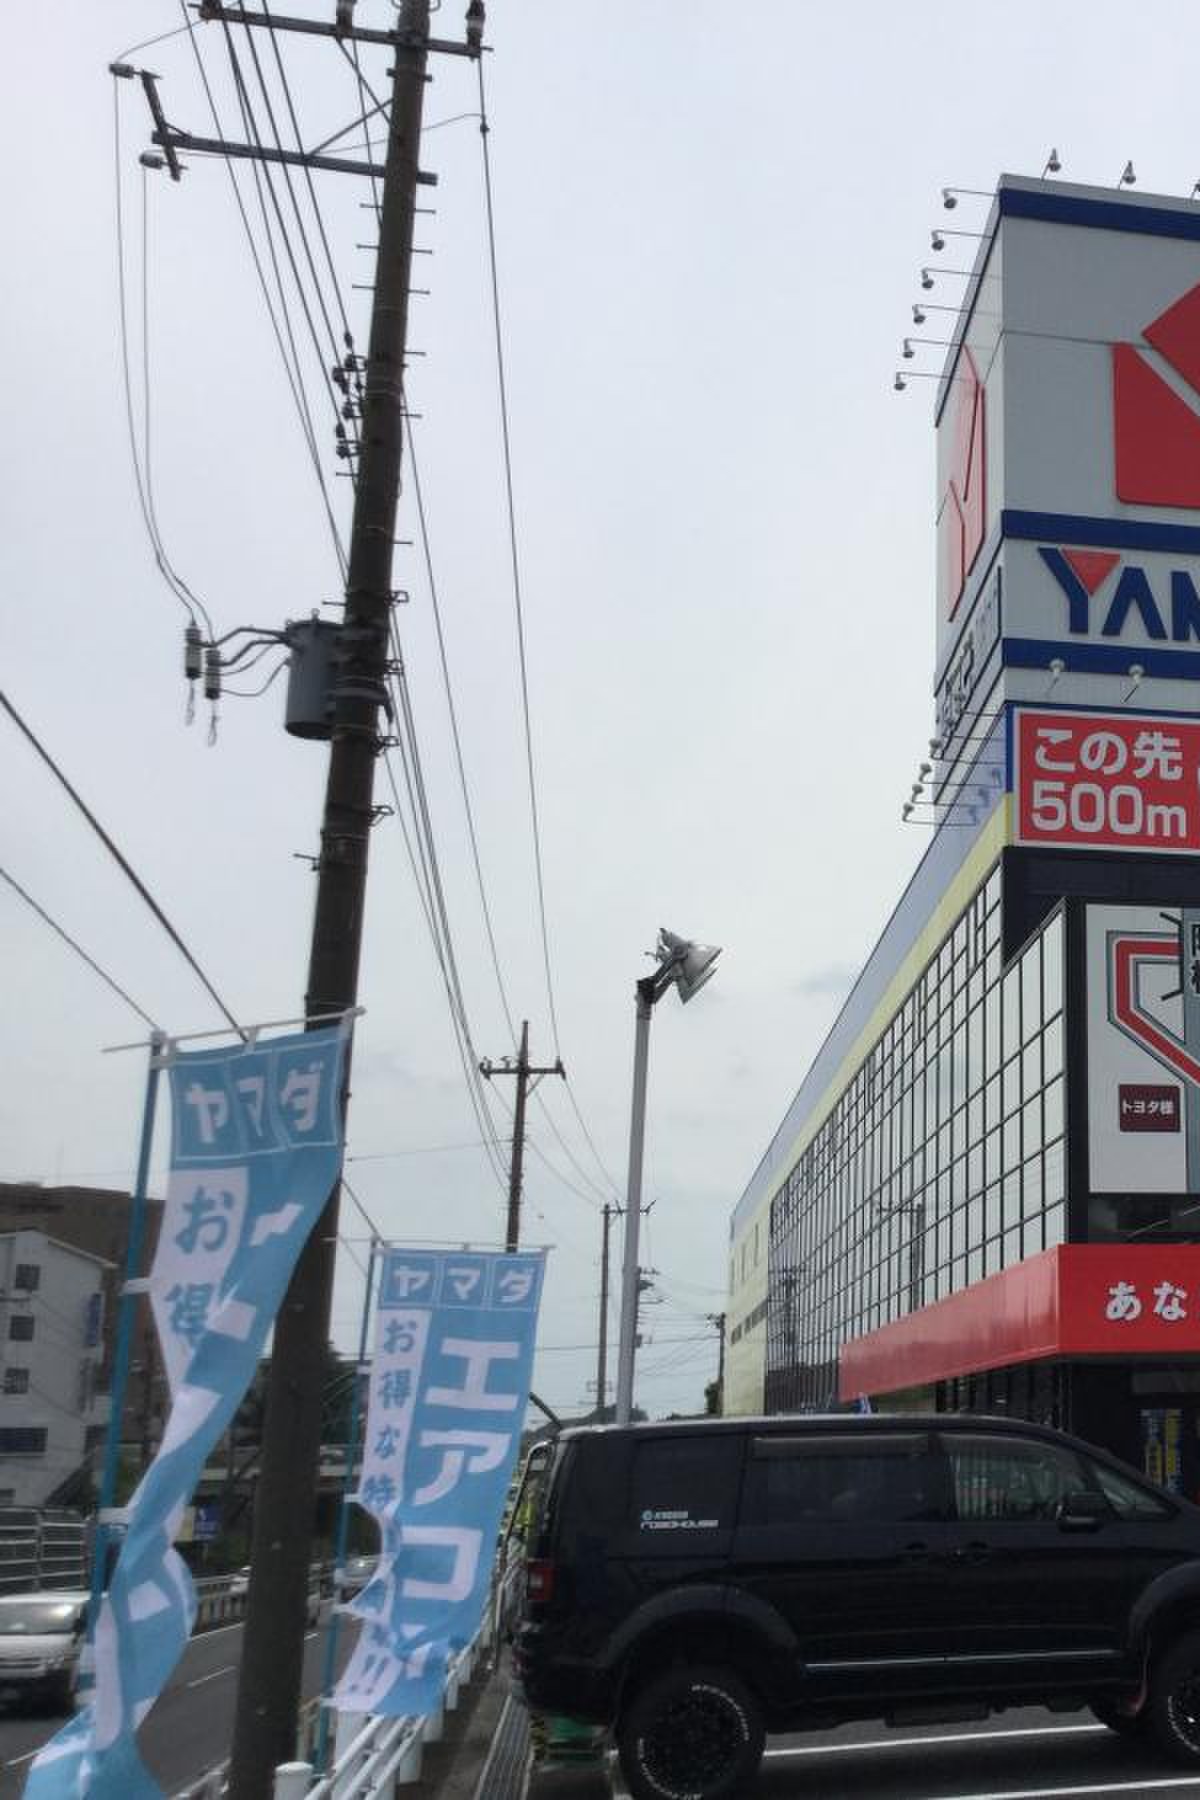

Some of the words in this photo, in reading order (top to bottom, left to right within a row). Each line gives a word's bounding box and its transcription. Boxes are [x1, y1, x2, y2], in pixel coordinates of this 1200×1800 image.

[1033, 728, 1184, 780] この先
[1031, 780, 1187, 839] 500m
[184, 1060, 324, 1144] ヤマダ
[1121, 1100, 1175, 1115] トヨタ様
[392, 1266, 534, 1303] ヤマダ
